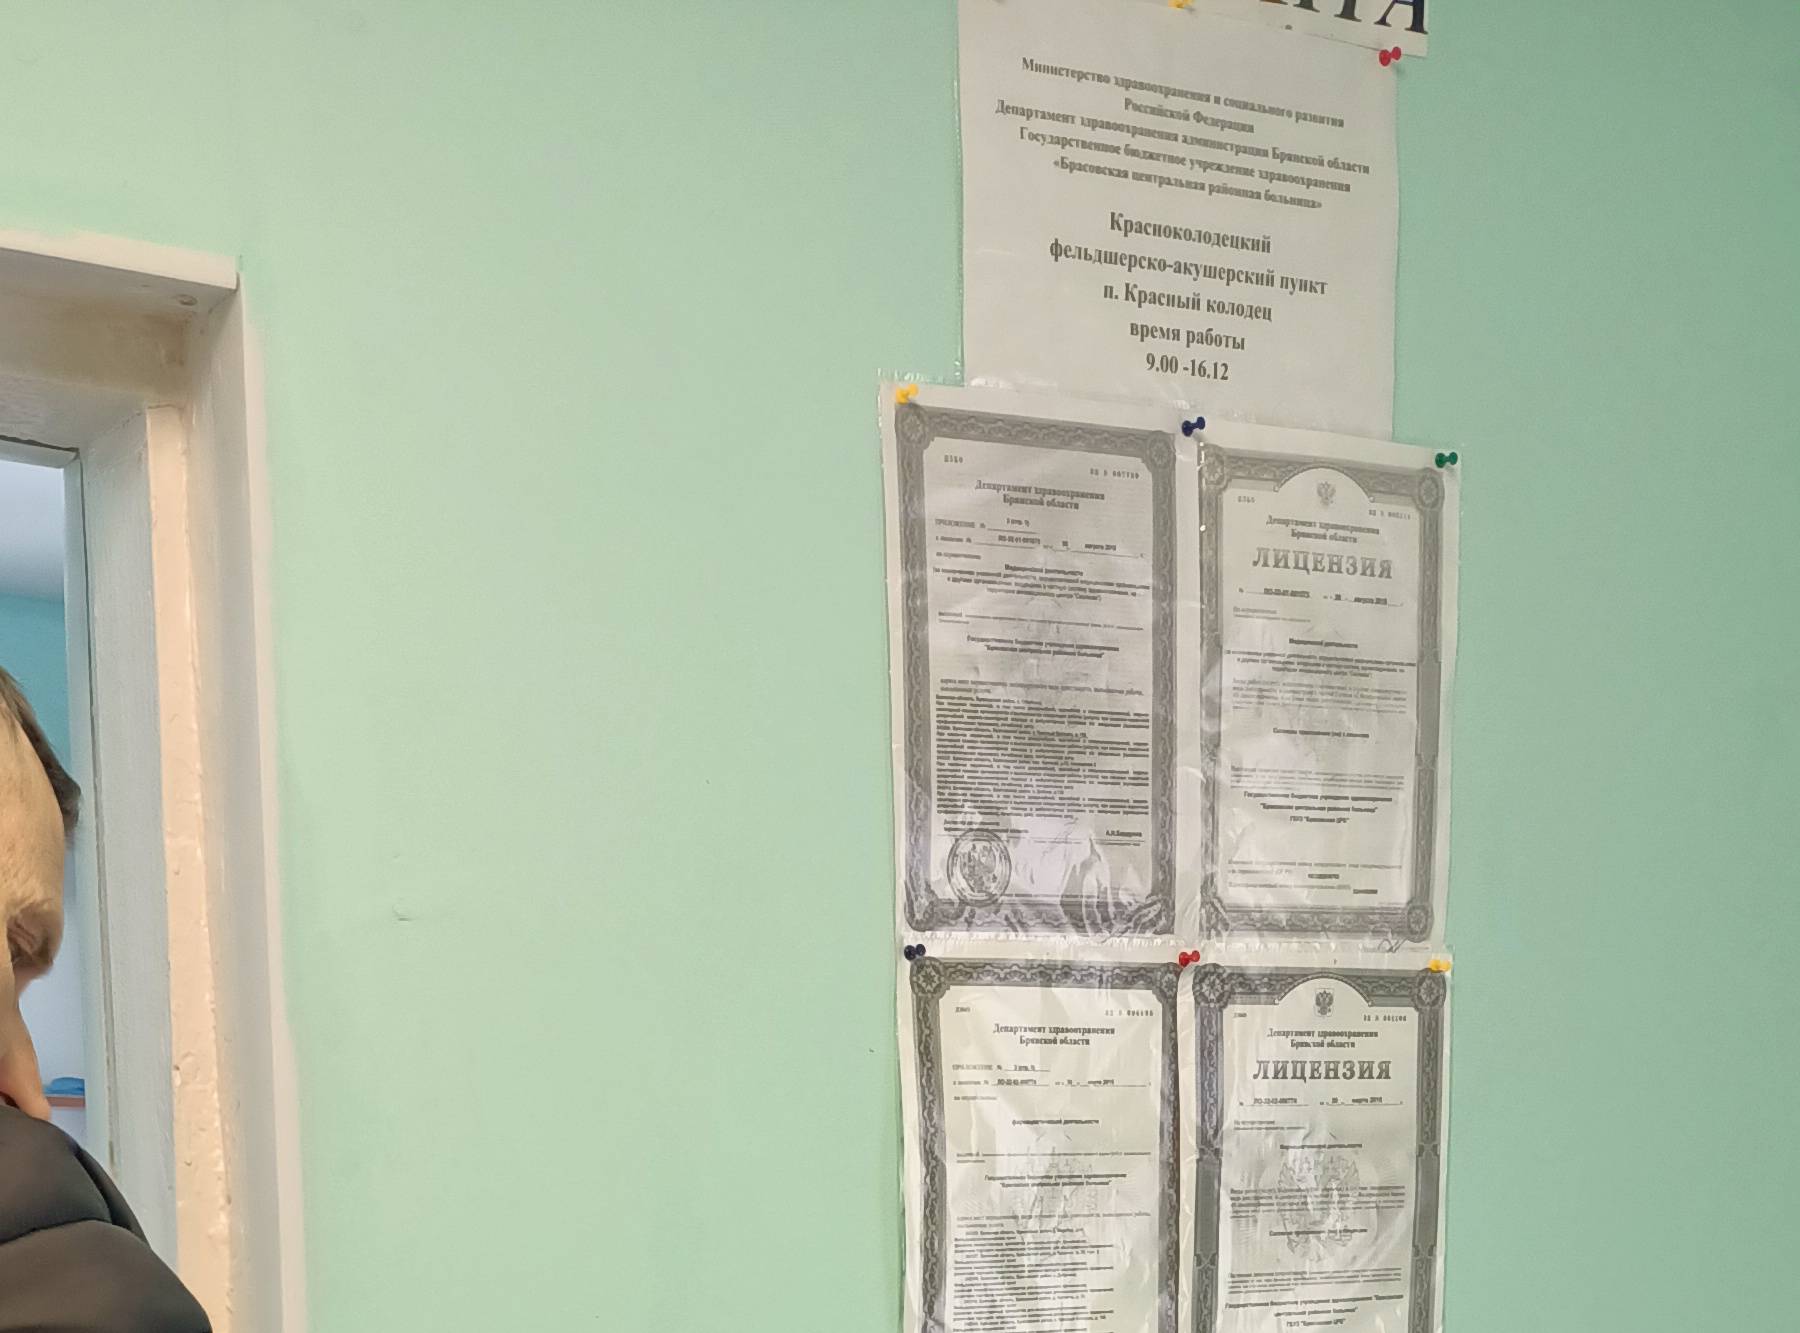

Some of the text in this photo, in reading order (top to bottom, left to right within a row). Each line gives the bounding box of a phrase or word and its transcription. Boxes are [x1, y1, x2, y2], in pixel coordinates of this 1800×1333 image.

[1022, 57, 1344, 128] Министерство здравоохранения и социального развития
[1125, 97, 1254, 133] Российской Федерации
[995, 99, 1369, 174] Департамент здравоохранения администрации Брянской области
[1020, 126, 1350, 192] Государственное бюджетное учреждение здравоохранения
[1053, 156, 1322, 208] «Брасовская центральная районная больница»
[1110, 212, 1271, 253] Красноколодецкий
[1050, 239, 1328, 295] фельдшерско-акушерский пункт
[1104, 284, 1272, 323] п. Красный колодец
[1130, 323, 1245, 350] время работы
[1146, 353, 1228, 380] 9.00 -16.12
[975, 480, 1105, 500] Департамент здравоохранения
[1003, 494, 1079, 510] Брянской области
[1252, 548, 1392, 579] ЛИЦЕНЗИЯ
[993, 1023, 1115, 1037] Департамент здравоохранения
[1020, 1035, 1090, 1047] Брянской области
[1267, 1028, 1315, 1040] Департамент
[1327, 1039, 1355, 1048] области
[1253, 1059, 1391, 1084] ЛИЦЕНЗИЯ
